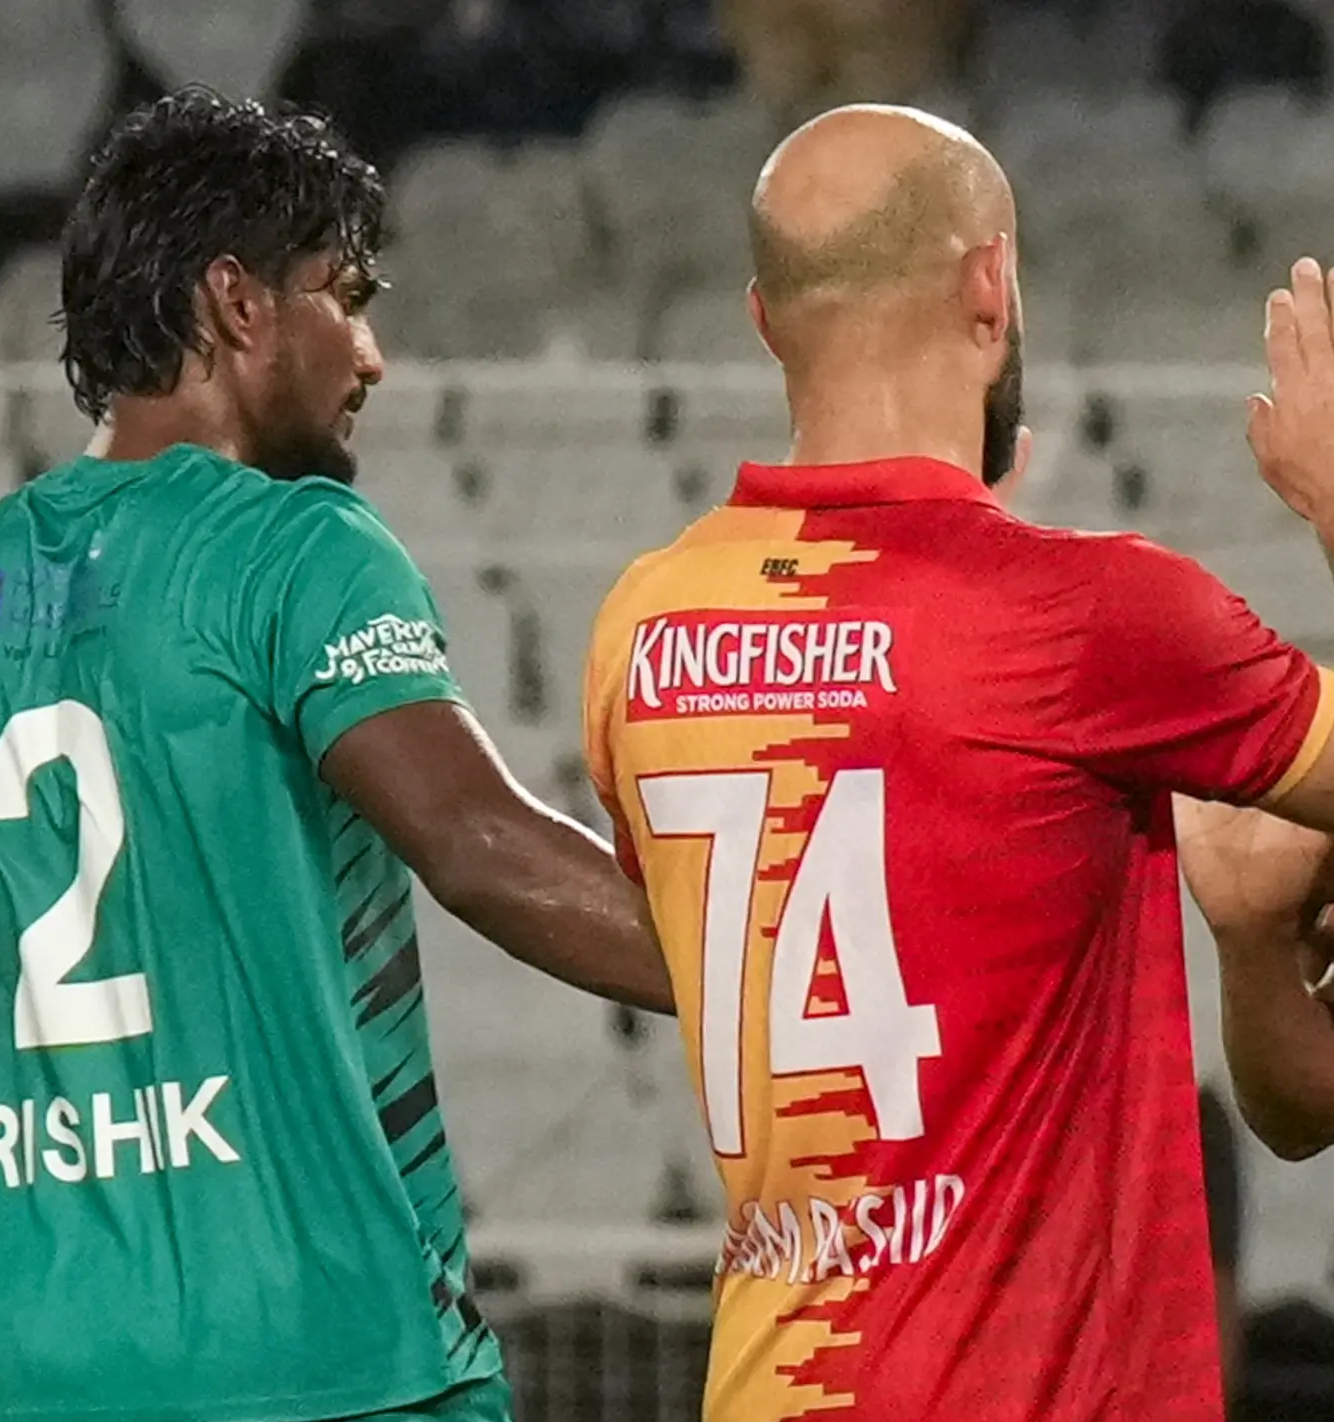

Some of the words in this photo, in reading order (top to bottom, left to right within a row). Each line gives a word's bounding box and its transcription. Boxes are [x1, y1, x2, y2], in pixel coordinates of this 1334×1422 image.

[629, 617, 898, 708] KINGFISHER
[676, 693, 751, 714] STRONG
[753, 692, 814, 711] POWER
[818, 690, 867, 709] SODA
[637, 768, 943, 1157] 74
